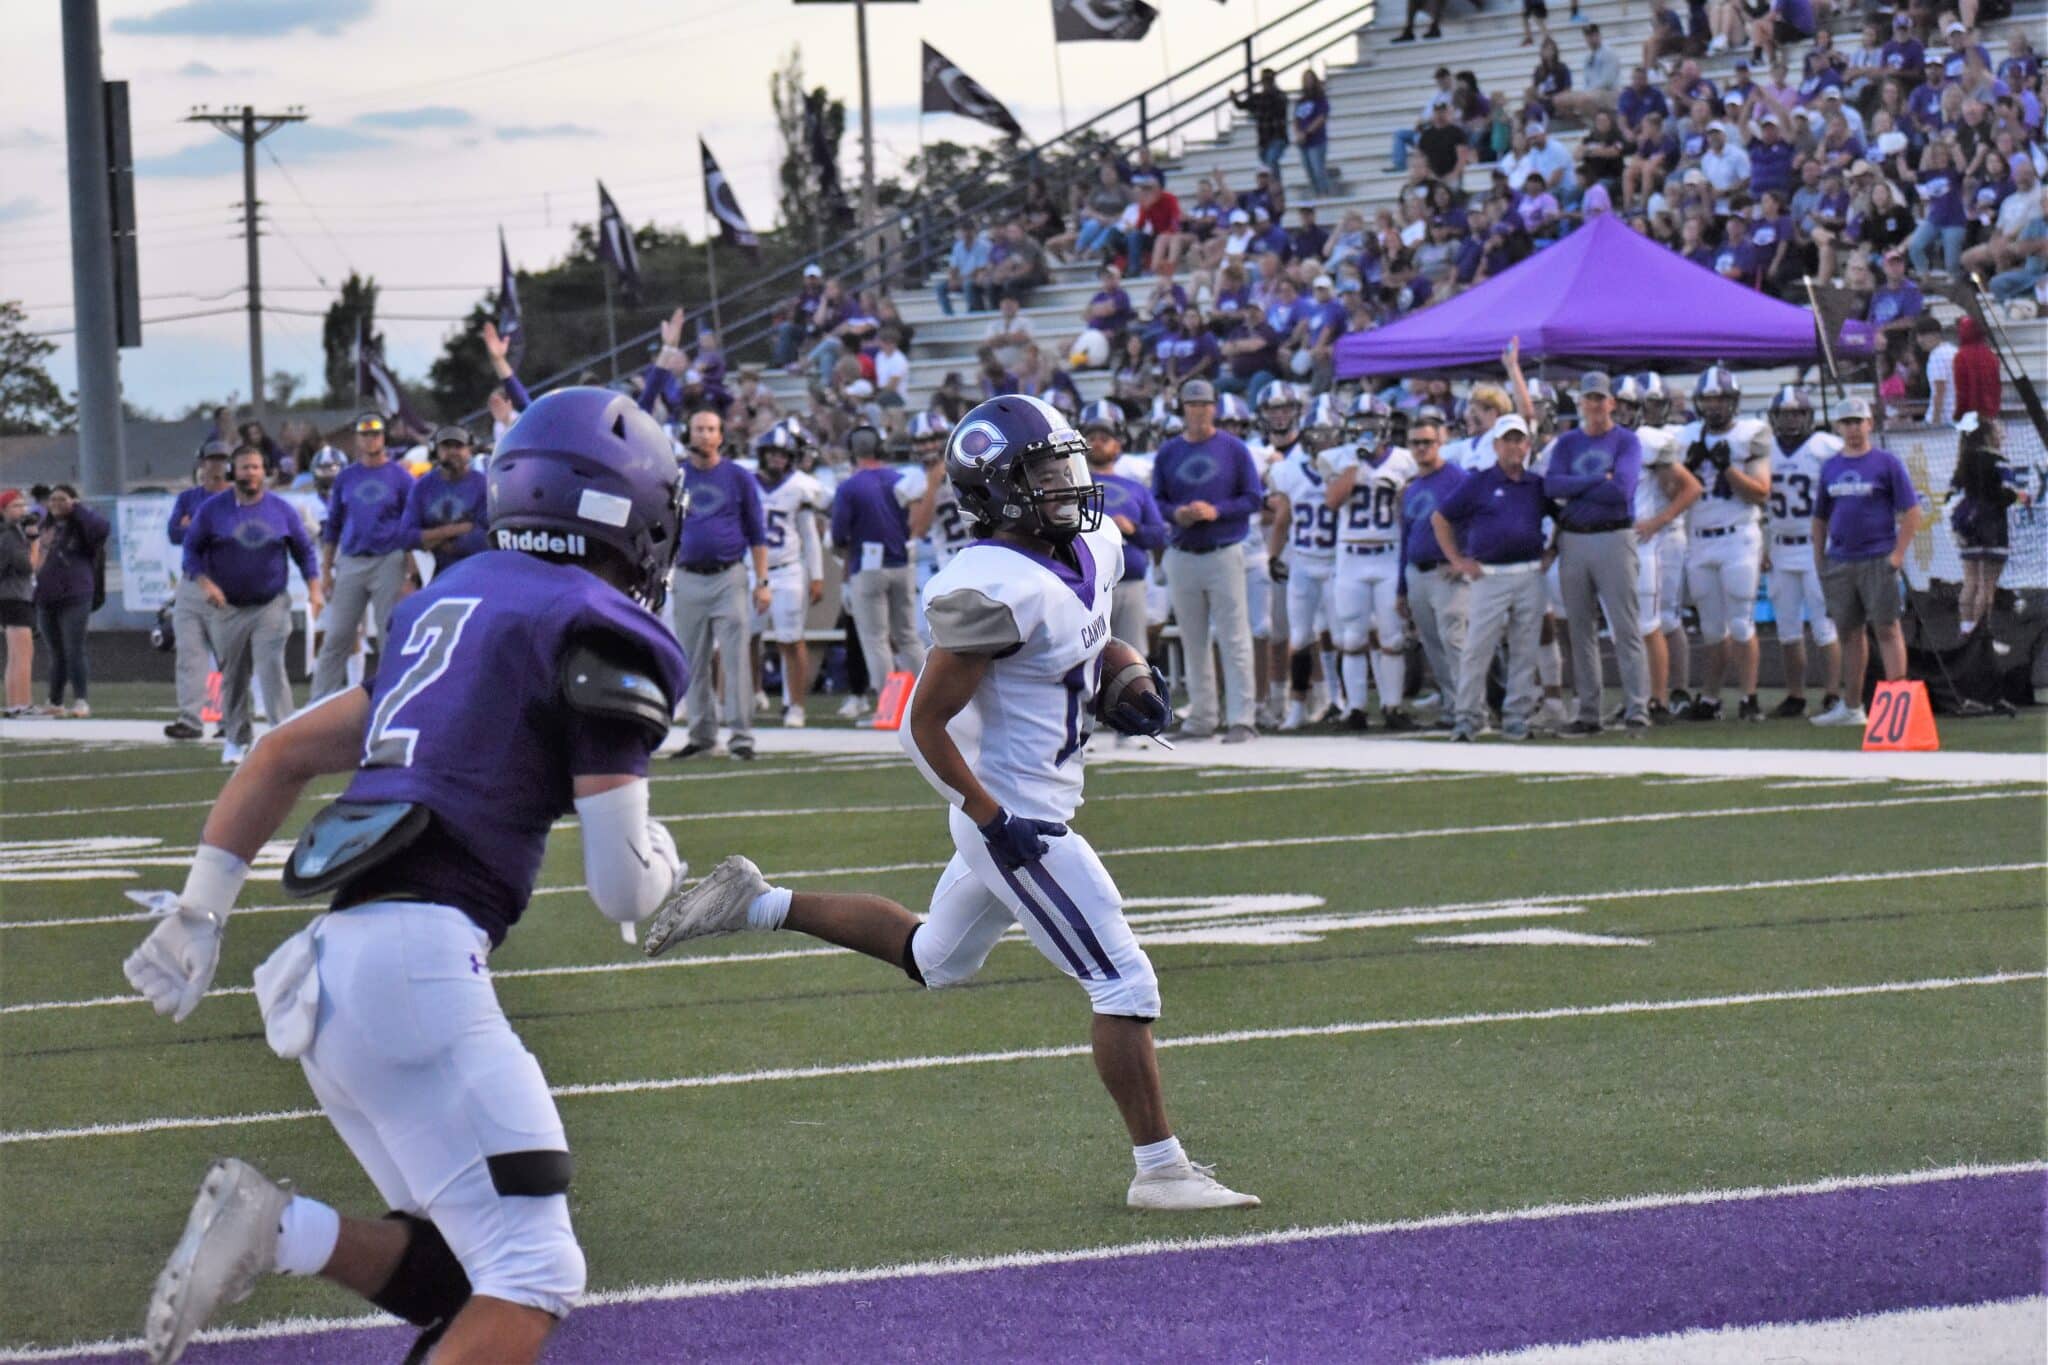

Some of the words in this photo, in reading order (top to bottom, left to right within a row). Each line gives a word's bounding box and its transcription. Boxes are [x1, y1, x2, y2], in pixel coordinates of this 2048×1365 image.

[1348, 483, 1395, 530] 20
[1771, 474, 1813, 519] 53
[497, 529, 586, 557] Riddell
[1294, 502, 1339, 549] 29
[360, 597, 483, 768] 2
[1867, 690, 1911, 744] 20
